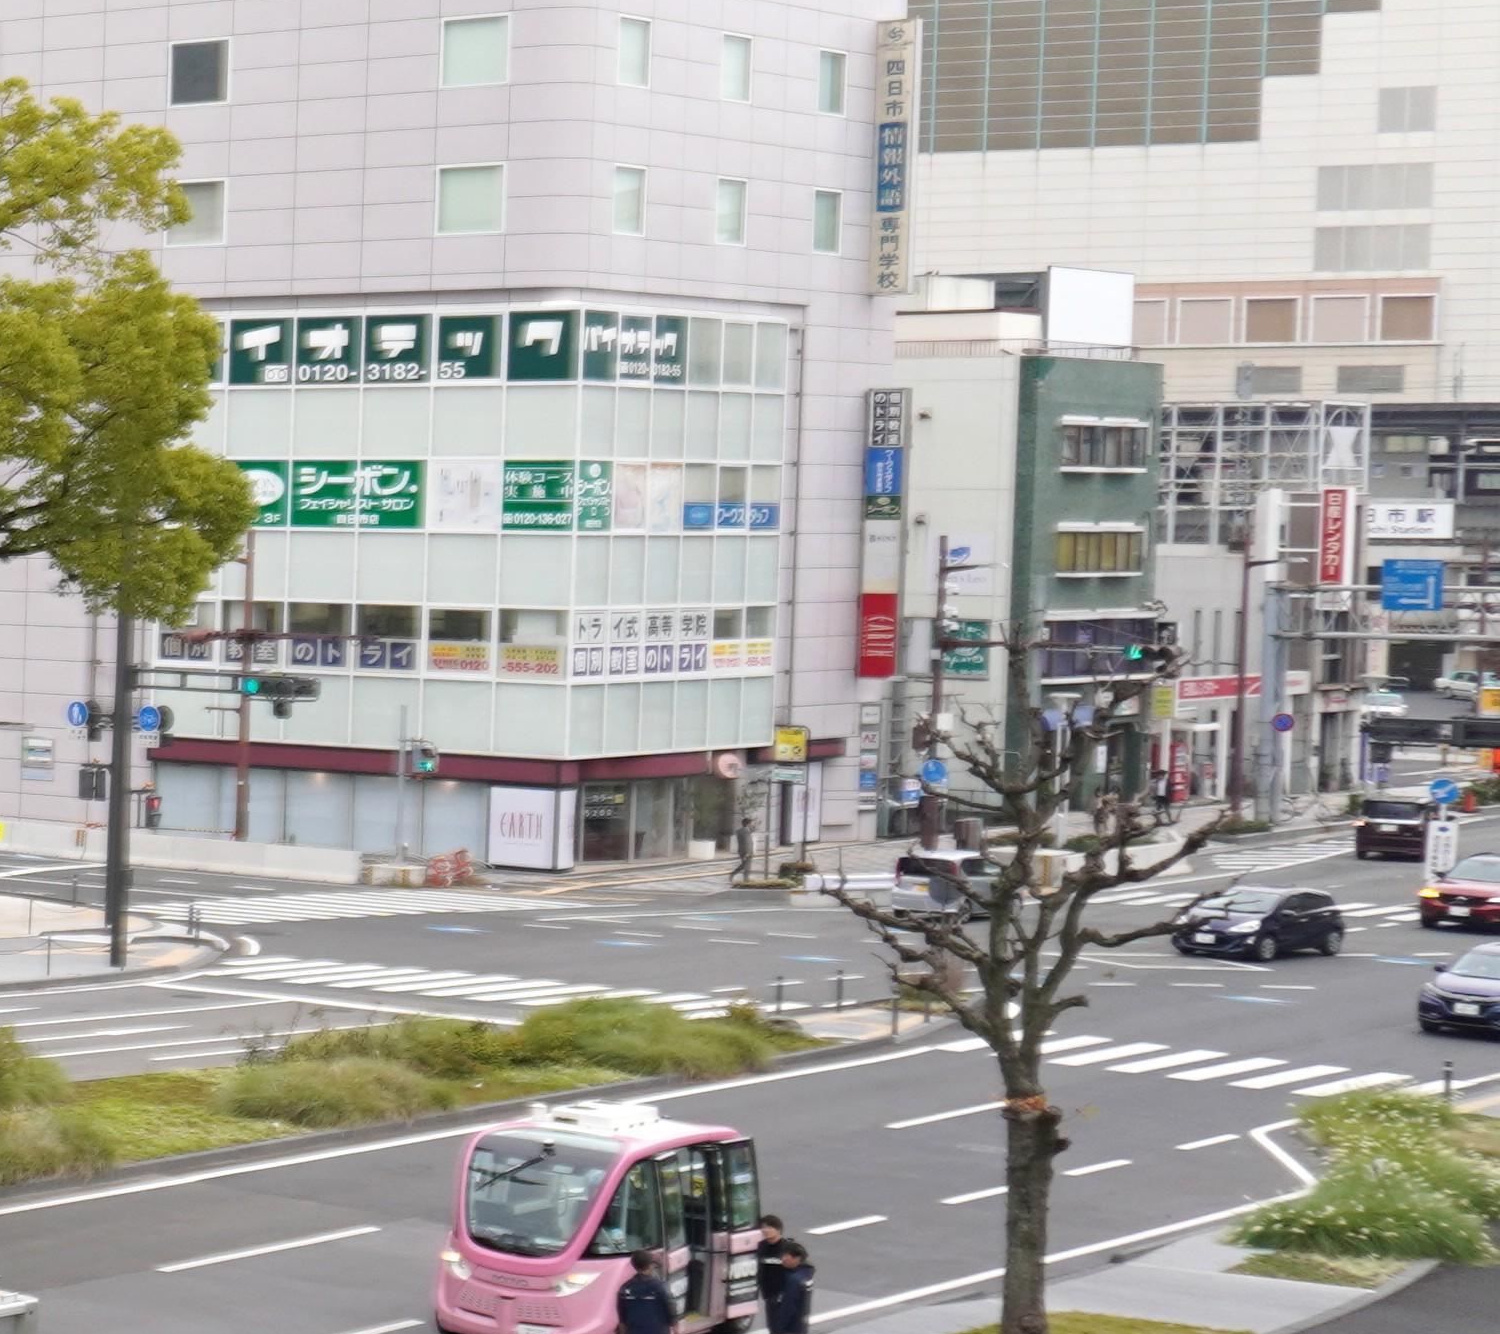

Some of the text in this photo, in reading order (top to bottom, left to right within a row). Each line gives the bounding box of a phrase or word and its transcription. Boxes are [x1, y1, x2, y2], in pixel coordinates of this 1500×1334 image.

[504, 470, 574, 484] 体験コース
[381, 499, 415, 510] サロン
[578, 614, 708, 639] トライ式高等学院
[574, 643, 707, 676] 個別教室のトライ
[500, 811, 543, 841] EARTH
